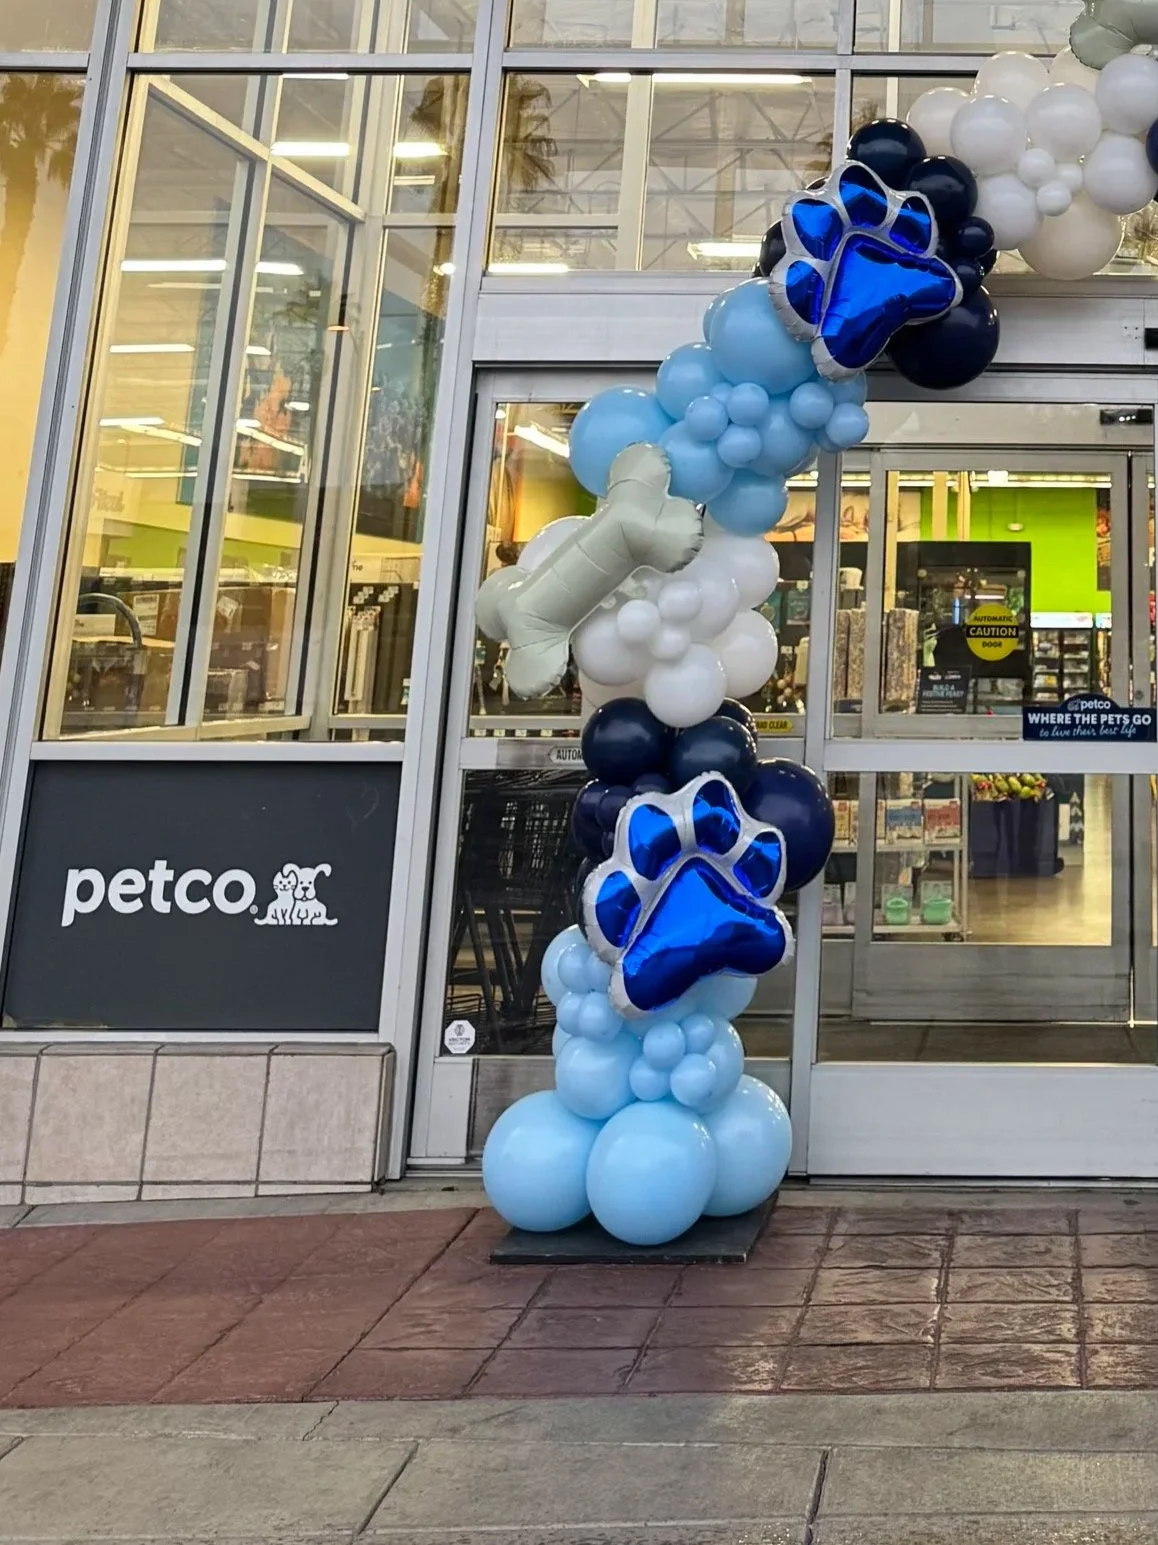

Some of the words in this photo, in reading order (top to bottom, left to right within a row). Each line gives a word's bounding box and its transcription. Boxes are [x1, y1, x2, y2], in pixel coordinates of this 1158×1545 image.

[973, 614, 1014, 623] AUTOMATIC
[969, 626, 1017, 638] CAUTION
[982, 640, 1003, 648] DOOR
[1080, 699, 1111, 711] petco
[769, 720, 788, 729] CLEAR
[1027, 712, 1072, 724] WHERE
[1073, 713, 1098, 724] THE
[1100, 713, 1130, 725] PETS
[1132, 714, 1152, 725] GO
[1039, 727, 1049, 738] to
[1051, 724, 1071, 737] live
[1072, 725, 1097, 737] their
[1099, 724, 1119, 736] best
[1119, 722, 1137, 738] life
[61, 860, 257, 928] petco
